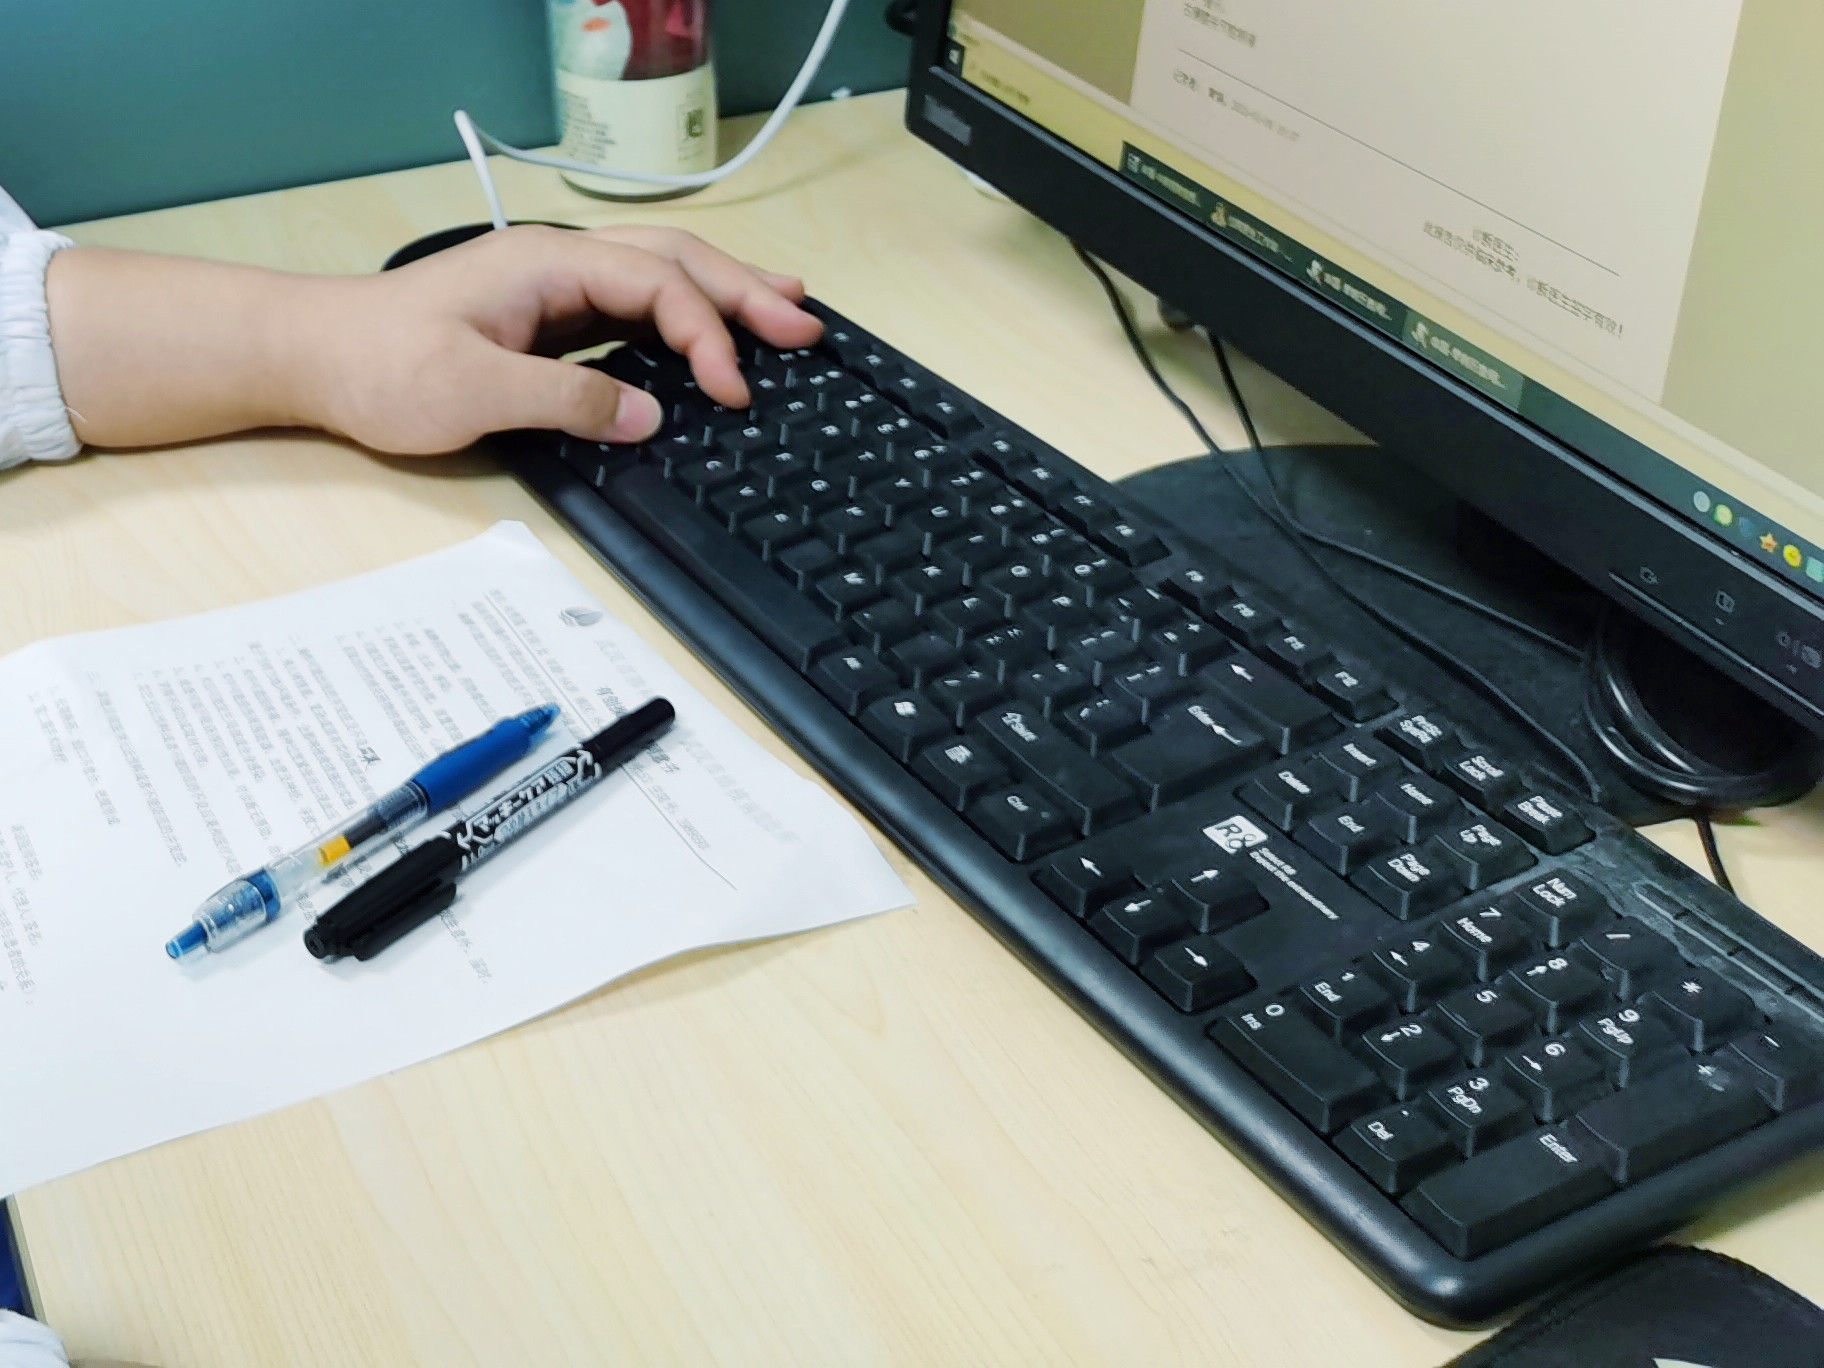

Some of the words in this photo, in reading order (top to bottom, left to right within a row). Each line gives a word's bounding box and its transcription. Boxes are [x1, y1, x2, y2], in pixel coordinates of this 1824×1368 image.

[788, 401, 805, 412] E
[821, 425, 840, 436] R
[706, 460, 723, 471] C
[858, 451, 875, 462] T
[894, 478, 912, 488] Y
[931, 505, 949, 518] U
[1011, 564, 1031, 578] O
[1185, 570, 1205, 583] F9
[1052, 595, 1073, 608] P
[1232, 603, 1256, 618] F10
[1187, 705, 1214, 726] Enter
[1343, 742, 1376, 768] Insert
[1459, 760, 1487, 782] Lock
[1471, 755, 1505, 778] Scroll
[1278, 770, 1311, 794] Delete
[1399, 783, 1434, 805] Home
[1517, 800, 1550, 824] Break
[1530, 795, 1564, 819] Pause
[1338, 815, 1365, 834] End
[1459, 829, 1477, 844] Up
[1471, 824, 1502, 847] Page
[1387, 858, 1420, 882] Down
[1399, 853, 1431, 876] Page
[1532, 883, 1567, 909] Lock
[1546, 878, 1577, 900] Num
[1479, 907, 1502, 918] 7
[1457, 917, 1493, 944] Home
[1412, 941, 1431, 953] 4
[1548, 957, 1568, 970] 8
[1314, 982, 1343, 1003] End
[1476, 989, 1499, 1004] 5
[1265, 1003, 1285, 1016] 0
[1618, 1009, 1640, 1023] 9
[1240, 1013, 1263, 1031] Ins
[1400, 1024, 1423, 1037] 2
[1597, 1018, 1634, 1045] PgUp
[1544, 1042, 1566, 1057] 6
[1468, 1077, 1490, 1092] 3
[1447, 1086, 1483, 1114] PgDn
[1367, 1121, 1395, 1141] Del
[1539, 1133, 1578, 1163] Enter
